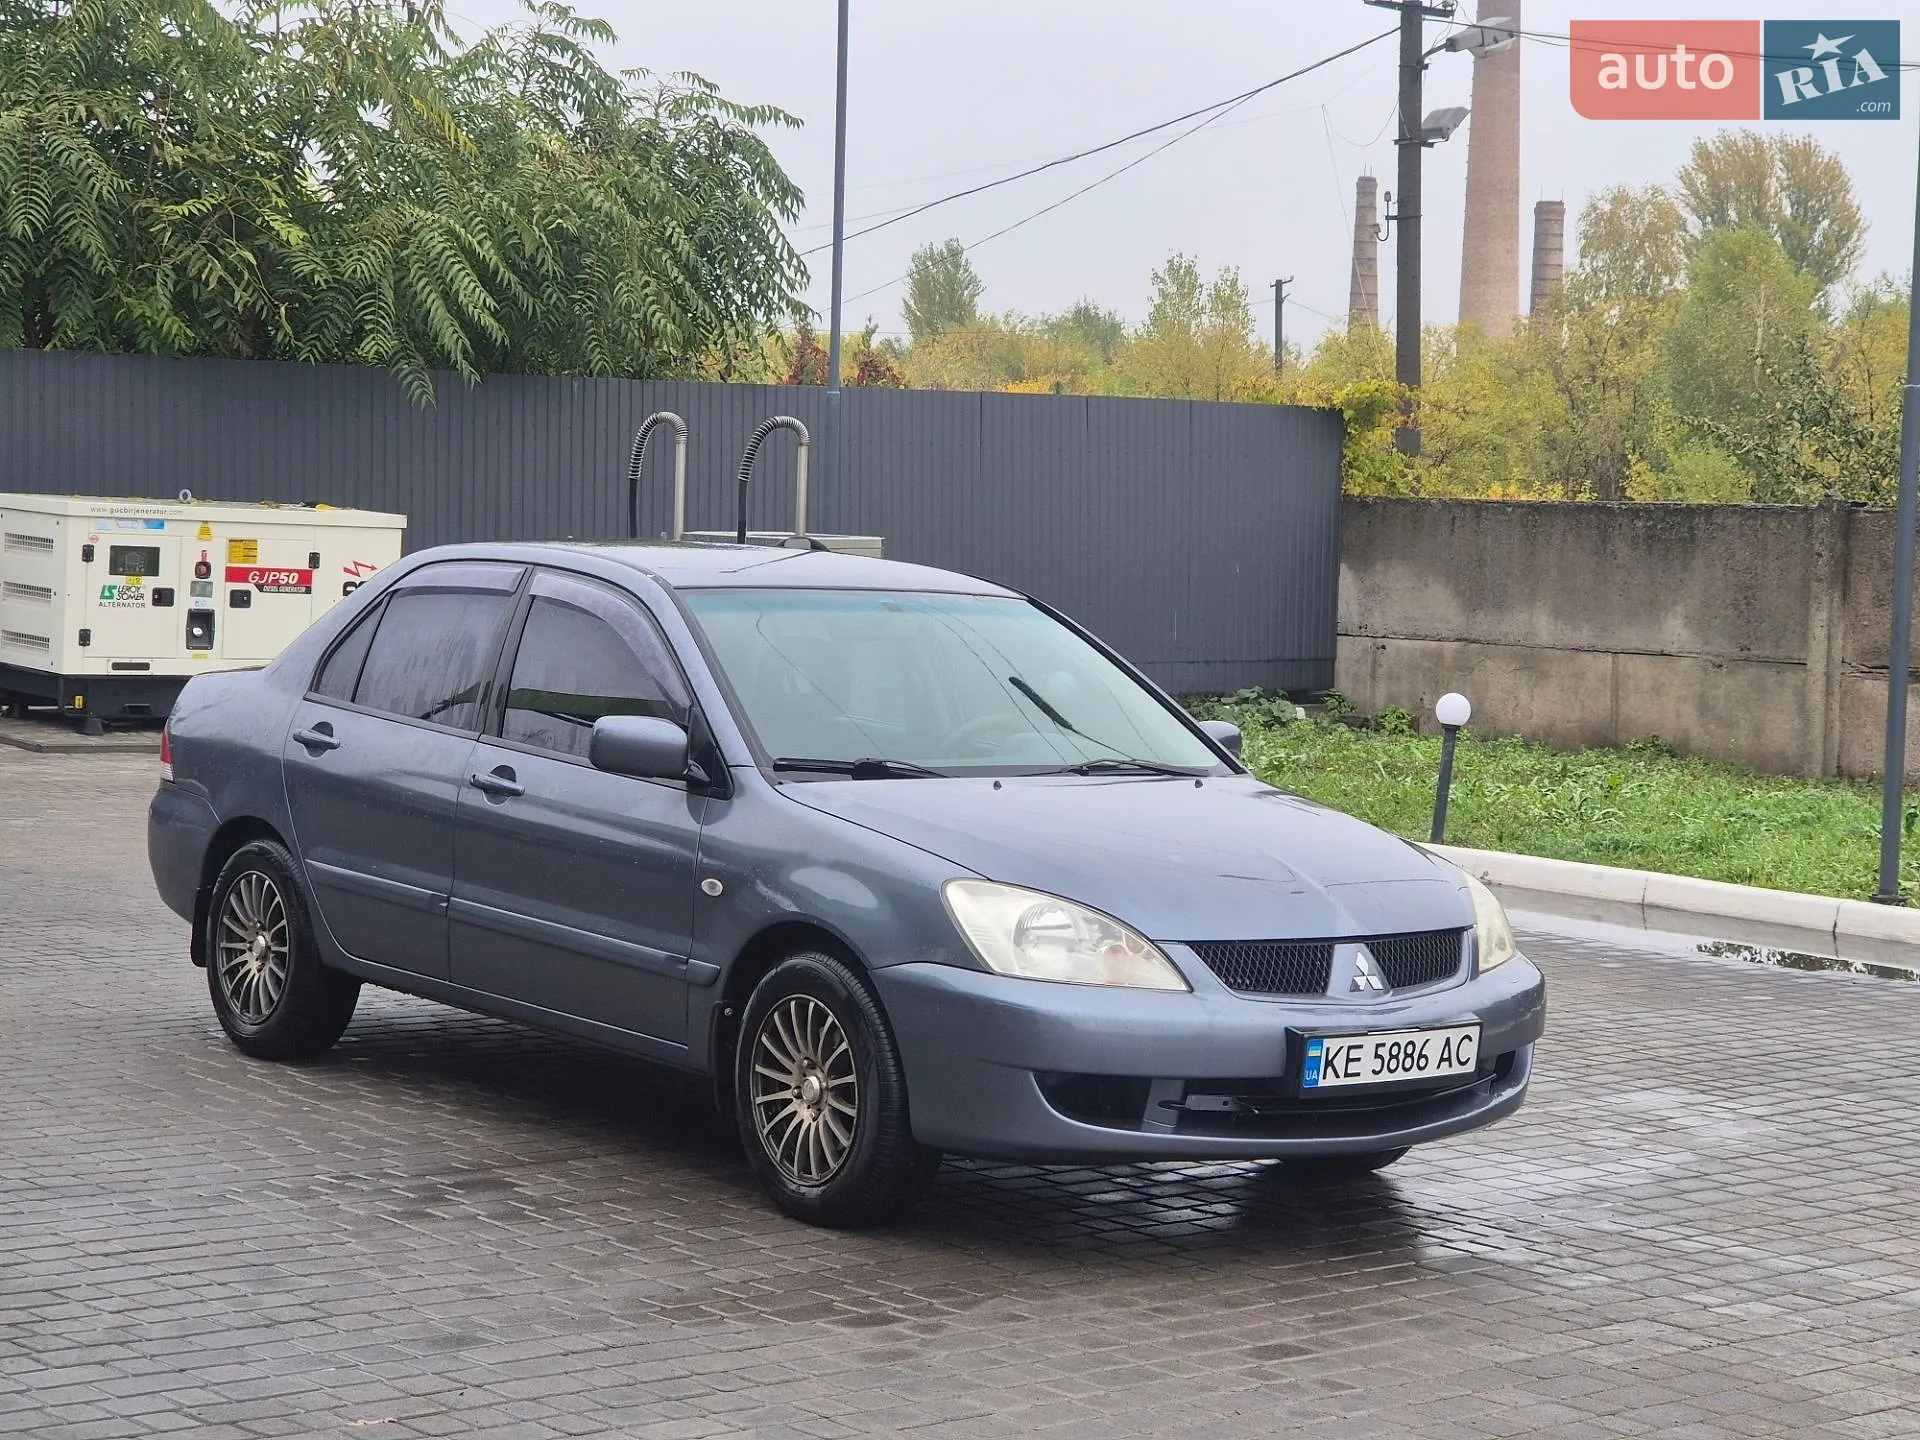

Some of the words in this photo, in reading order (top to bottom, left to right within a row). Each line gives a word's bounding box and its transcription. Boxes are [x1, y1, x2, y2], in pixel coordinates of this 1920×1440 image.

[248, 570, 299, 585] GJP50
[118, 585, 141, 593] LEROY
[116, 592, 145, 601] SOMER
[98, 601, 146, 609] ALTERNATOR
[1322, 1044, 1363, 1080] KE
[1371, 1038, 1431, 1076] 5886
[1436, 1034, 1473, 1070] AC
[1305, 1070, 1318, 1081] UA
